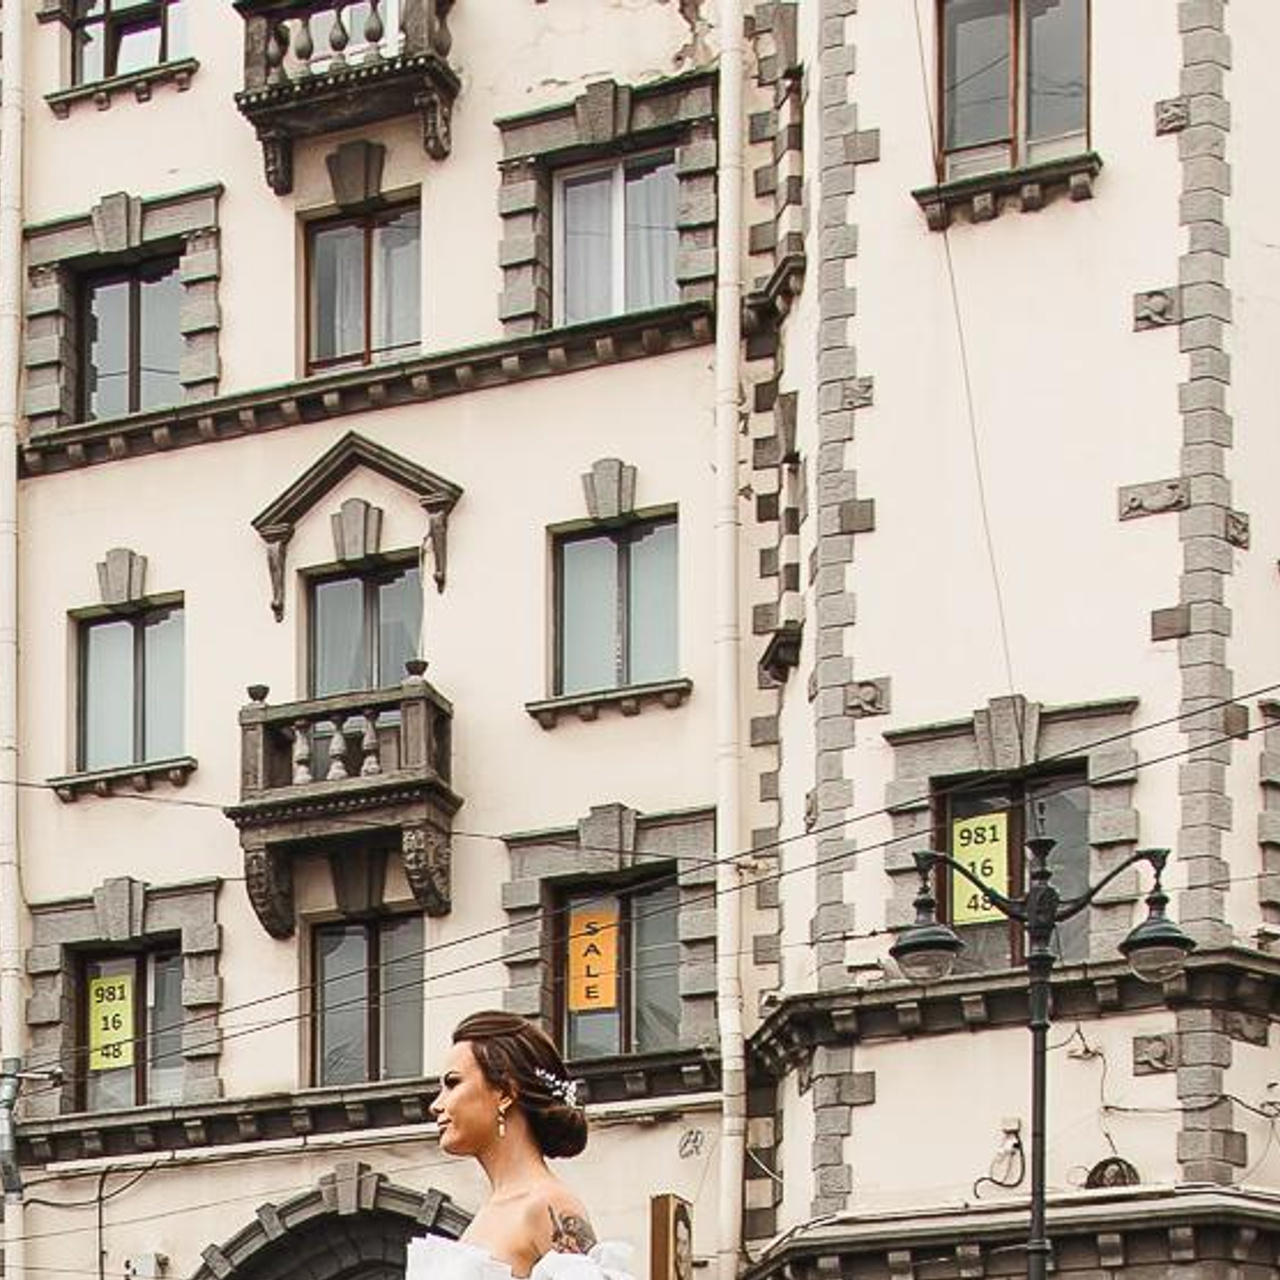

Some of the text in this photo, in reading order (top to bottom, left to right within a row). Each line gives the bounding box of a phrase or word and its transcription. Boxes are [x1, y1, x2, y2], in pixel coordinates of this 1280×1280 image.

[960, 825, 1000, 847] 981
[968, 858, 994, 877] 16
[967, 894, 991, 912] 48
[582, 922, 601, 999] SALE
[95, 984, 126, 1003] 981
[101, 1013, 122, 1031] 16
[101, 1043, 122, 1058] 48
